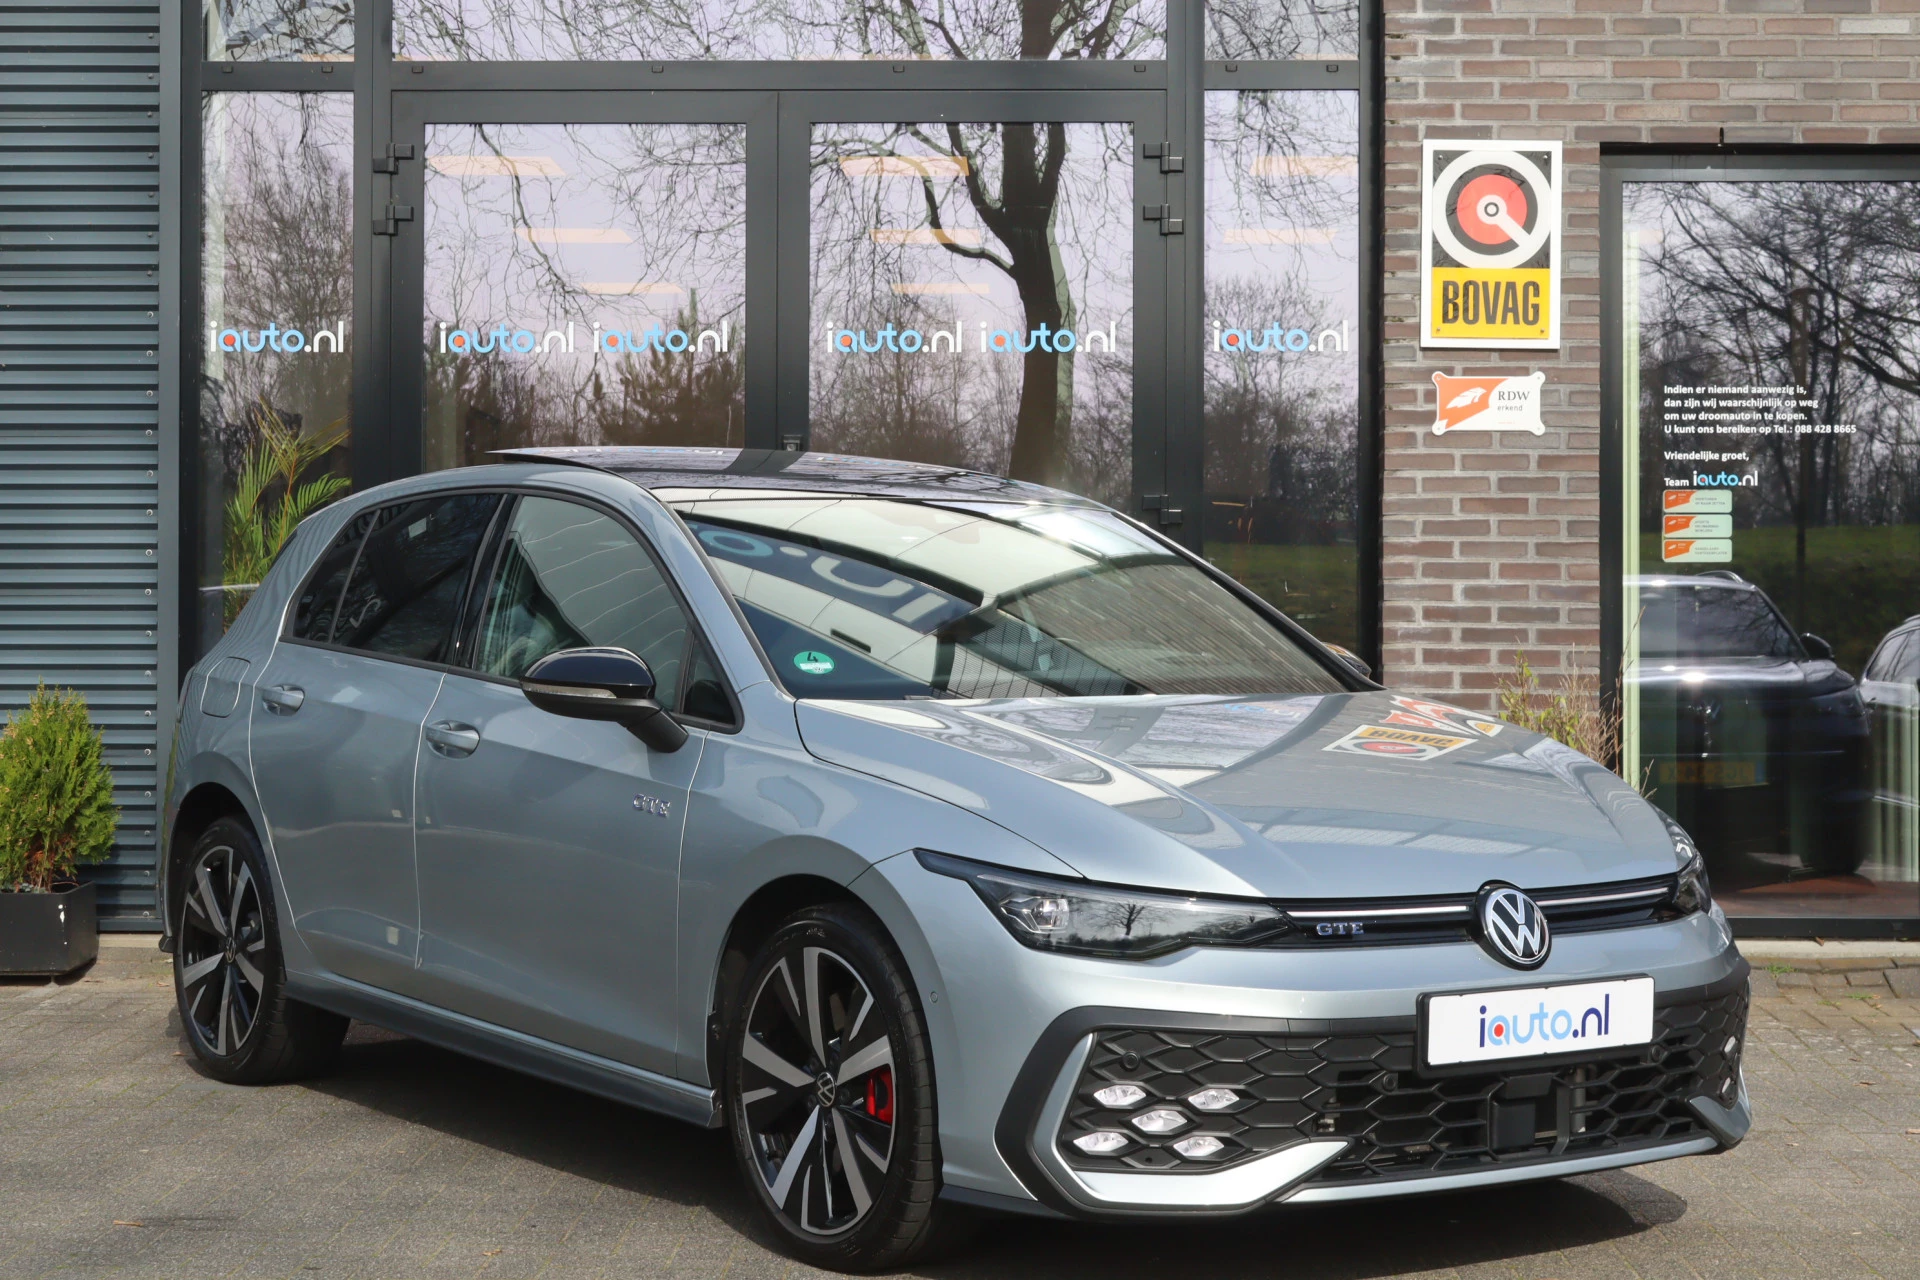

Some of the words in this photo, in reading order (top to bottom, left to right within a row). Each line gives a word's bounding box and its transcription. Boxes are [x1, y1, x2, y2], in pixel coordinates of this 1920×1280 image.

[1442, 280, 1540, 326] BOVAG
[210, 320, 344, 353] iauto.nl
[439, 320, 574, 353] iauto.nl
[593, 320, 728, 353] iauto.nl
[827, 320, 962, 353] iauto.nl
[980, 320, 1116, 353] iauto.nl
[1213, 320, 1349, 352] iauto.nl
[1498, 390, 1530, 401] RDW
[1664, 385, 1694, 394] Indien
[1695, 386, 1706, 394] er
[1707, 385, 1749, 394] niemand
[1751, 385, 1794, 395] aanwezig
[1796, 385, 1807, 395] is,
[1497, 404, 1523, 412] erkend
[1664, 398, 1682, 407] dan
[1684, 398, 1700, 409] zijn
[1702, 398, 1717, 409] wij
[1718, 398, 1783, 409] waarschijnlijk
[1784, 399, 1797, 409] op
[1799, 399, 1819, 409] weg
[1698, 411, 1751, 420] droomauto
[1752, 411, 1762, 420] in
[1763, 412, 1774, 420] te
[1776, 411, 1808, 421] kopen.
[1664, 425, 1672, 433] U
[1673, 424, 1696, 433] kunt
[1716, 424, 1757, 433] bereiken
[1758, 426, 1772, 435] op
[1773, 424, 1793, 433] Tel.:
[1794, 424, 1812, 433] 088
[1814, 424, 1832, 433] 428
[1833, 424, 1857, 433] 8665
[1664, 451, 1720, 462] Vriendelijke
[1721, 452, 1749, 461] groet,
[1664, 477, 1690, 486] Team
[1693, 470, 1758, 486] iauto.nl
[1316, 921, 1365, 936] GTE
[1479, 993, 1610, 1048] iauto.nl
